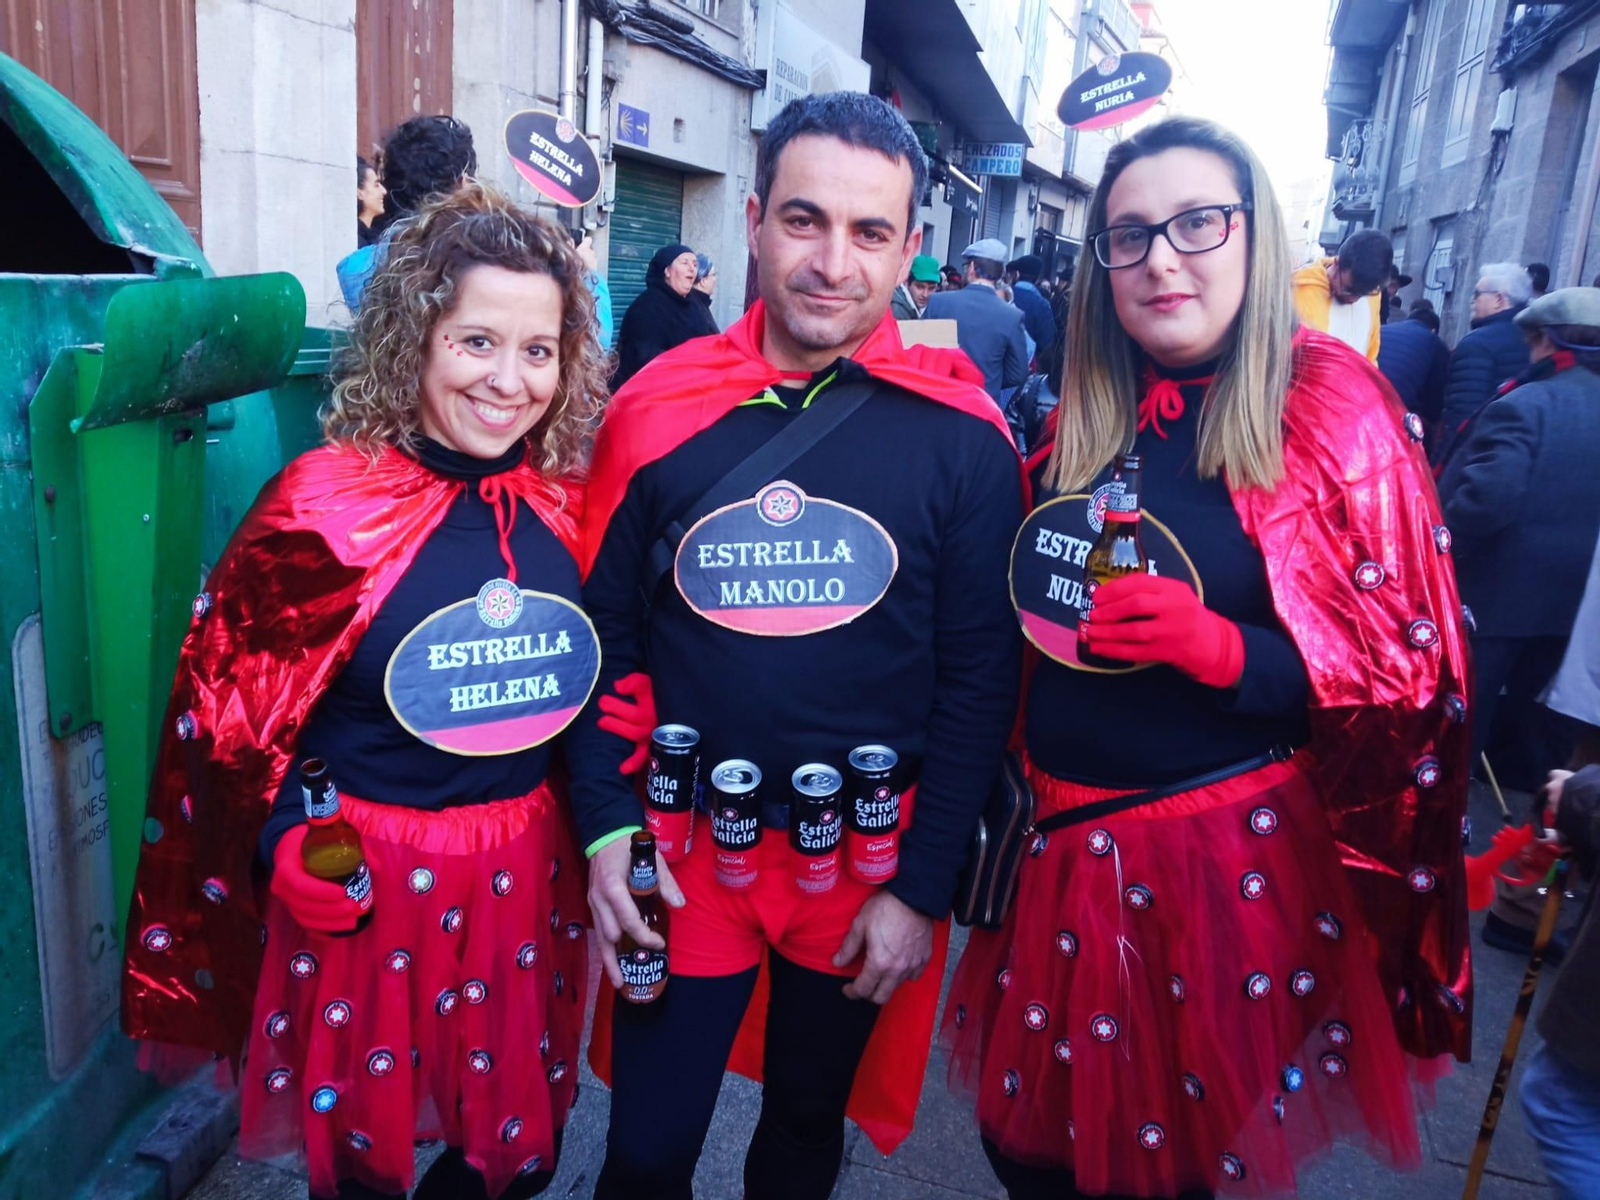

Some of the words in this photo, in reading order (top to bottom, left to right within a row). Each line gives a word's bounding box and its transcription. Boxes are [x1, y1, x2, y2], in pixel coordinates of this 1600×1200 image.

[1080, 71, 1147, 103] ESTRELLA
[1095, 90, 1135, 112] NURIA
[529, 131, 583, 177] ESTRELLA
[965, 144, 1021, 156] CALZADOS
[529, 150, 572, 186] HELENA
[963, 159, 1019, 173] CAMPERO
[698, 539, 855, 568] ESTRELLA
[719, 577, 845, 606] MANOLO
[427, 630, 573, 670] ESTRELLA
[449, 673, 561, 712] HELENA
[620, 958, 664, 975] Estrella
